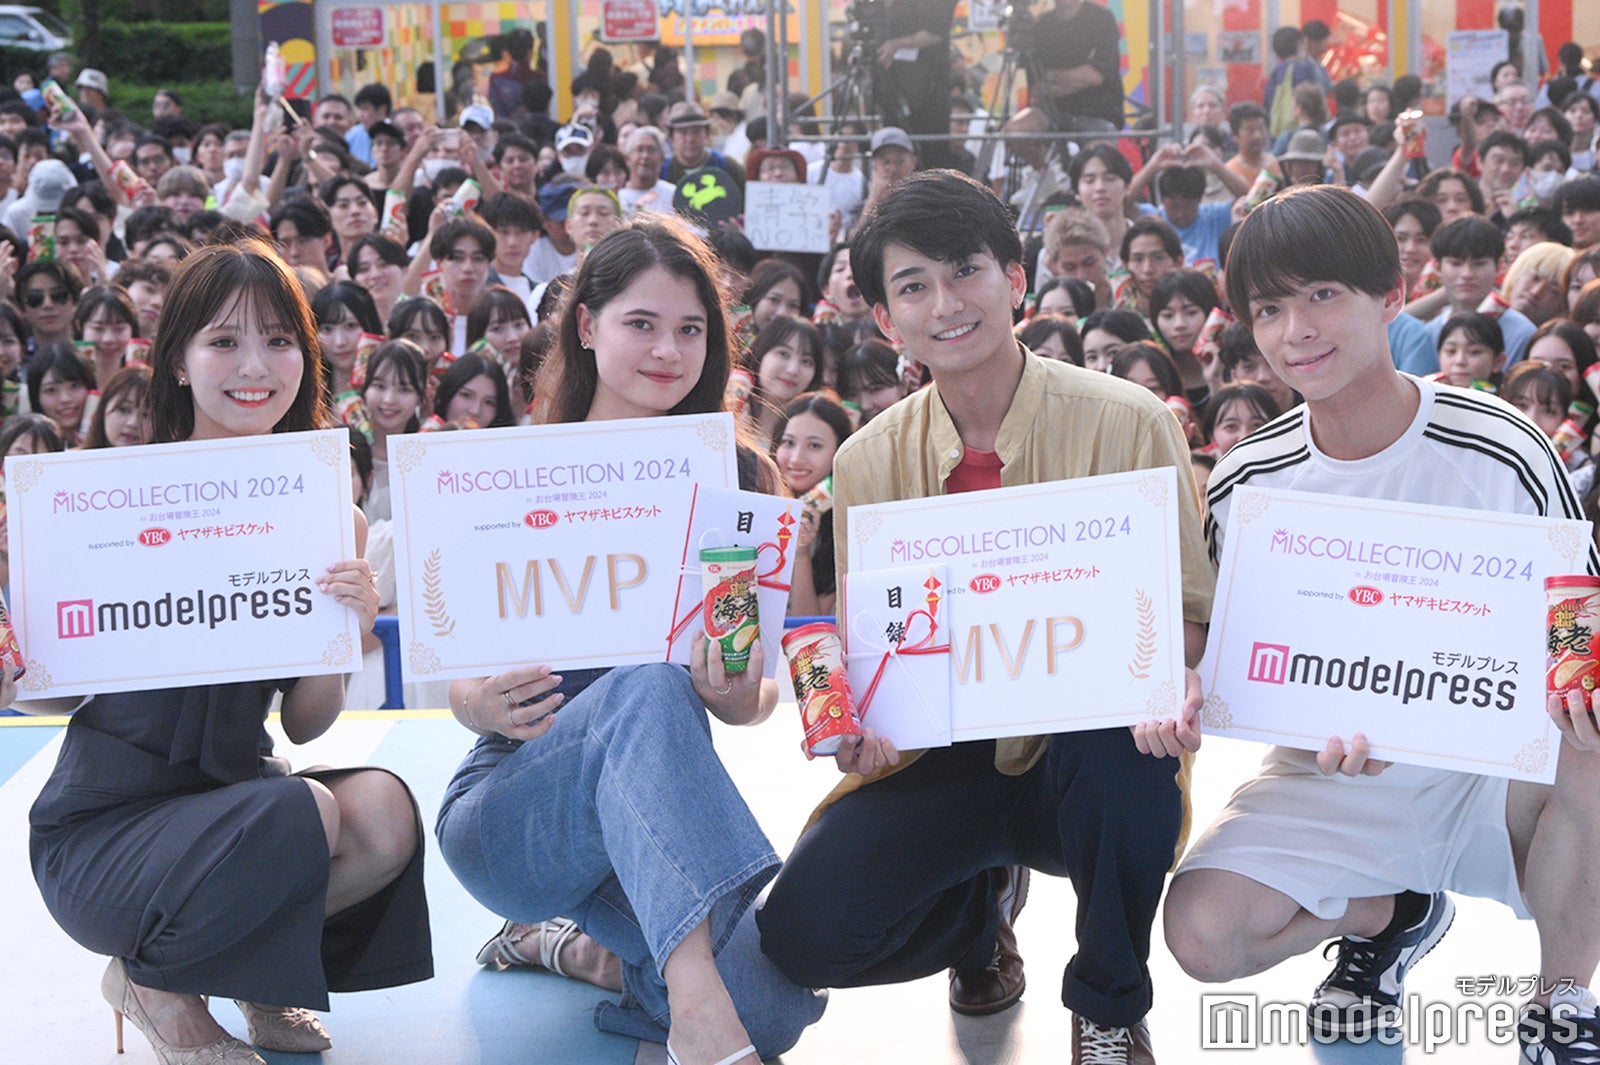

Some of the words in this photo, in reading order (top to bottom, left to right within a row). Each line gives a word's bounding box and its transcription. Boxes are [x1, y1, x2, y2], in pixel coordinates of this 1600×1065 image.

[437, 462, 624, 495] MISCOLLECTION
[633, 458, 692, 481] 2024
[53, 479, 238, 514] MISCOLLECTION
[247, 474, 305, 498] 2024
[588, 490, 607, 500] 2024
[202, 508, 221, 518] 2024
[529, 512, 555, 527] YBC
[564, 505, 662, 524] ヤマザキビスケット
[177, 521, 275, 541] ヤマザキビスケット
[474, 522, 511, 532] supported
[512, 521, 521, 529] by
[88, 540, 125, 550] supported
[126, 539, 135, 548] by
[142, 530, 168, 546] YBC
[891, 523, 1066, 562] MISCOLLECTION
[1075, 515, 1131, 541] 2024
[1031, 553, 1049, 563] 2024
[1270, 529, 1462, 573] MISCOLLECTION
[1471, 554, 1533, 581] 2024
[228, 568, 311, 587] モデルプレス
[974, 577, 998, 592] YBC
[1007, 565, 1101, 587] ヤマザキビスケット
[1419, 576, 1439, 587] 2024
[495, 553, 649, 619] MVP
[1297, 588, 1334, 600] supported
[1335, 592, 1344, 602] by
[1353, 589, 1380, 605] YBC
[1390, 592, 1492, 616] ヤマザキビスケット
[98, 586, 313, 632] modelpress
[950, 616, 1085, 684] MVP
[1432, 651, 1519, 674] モデルプレス
[1289, 653, 1517, 711] modelpress
